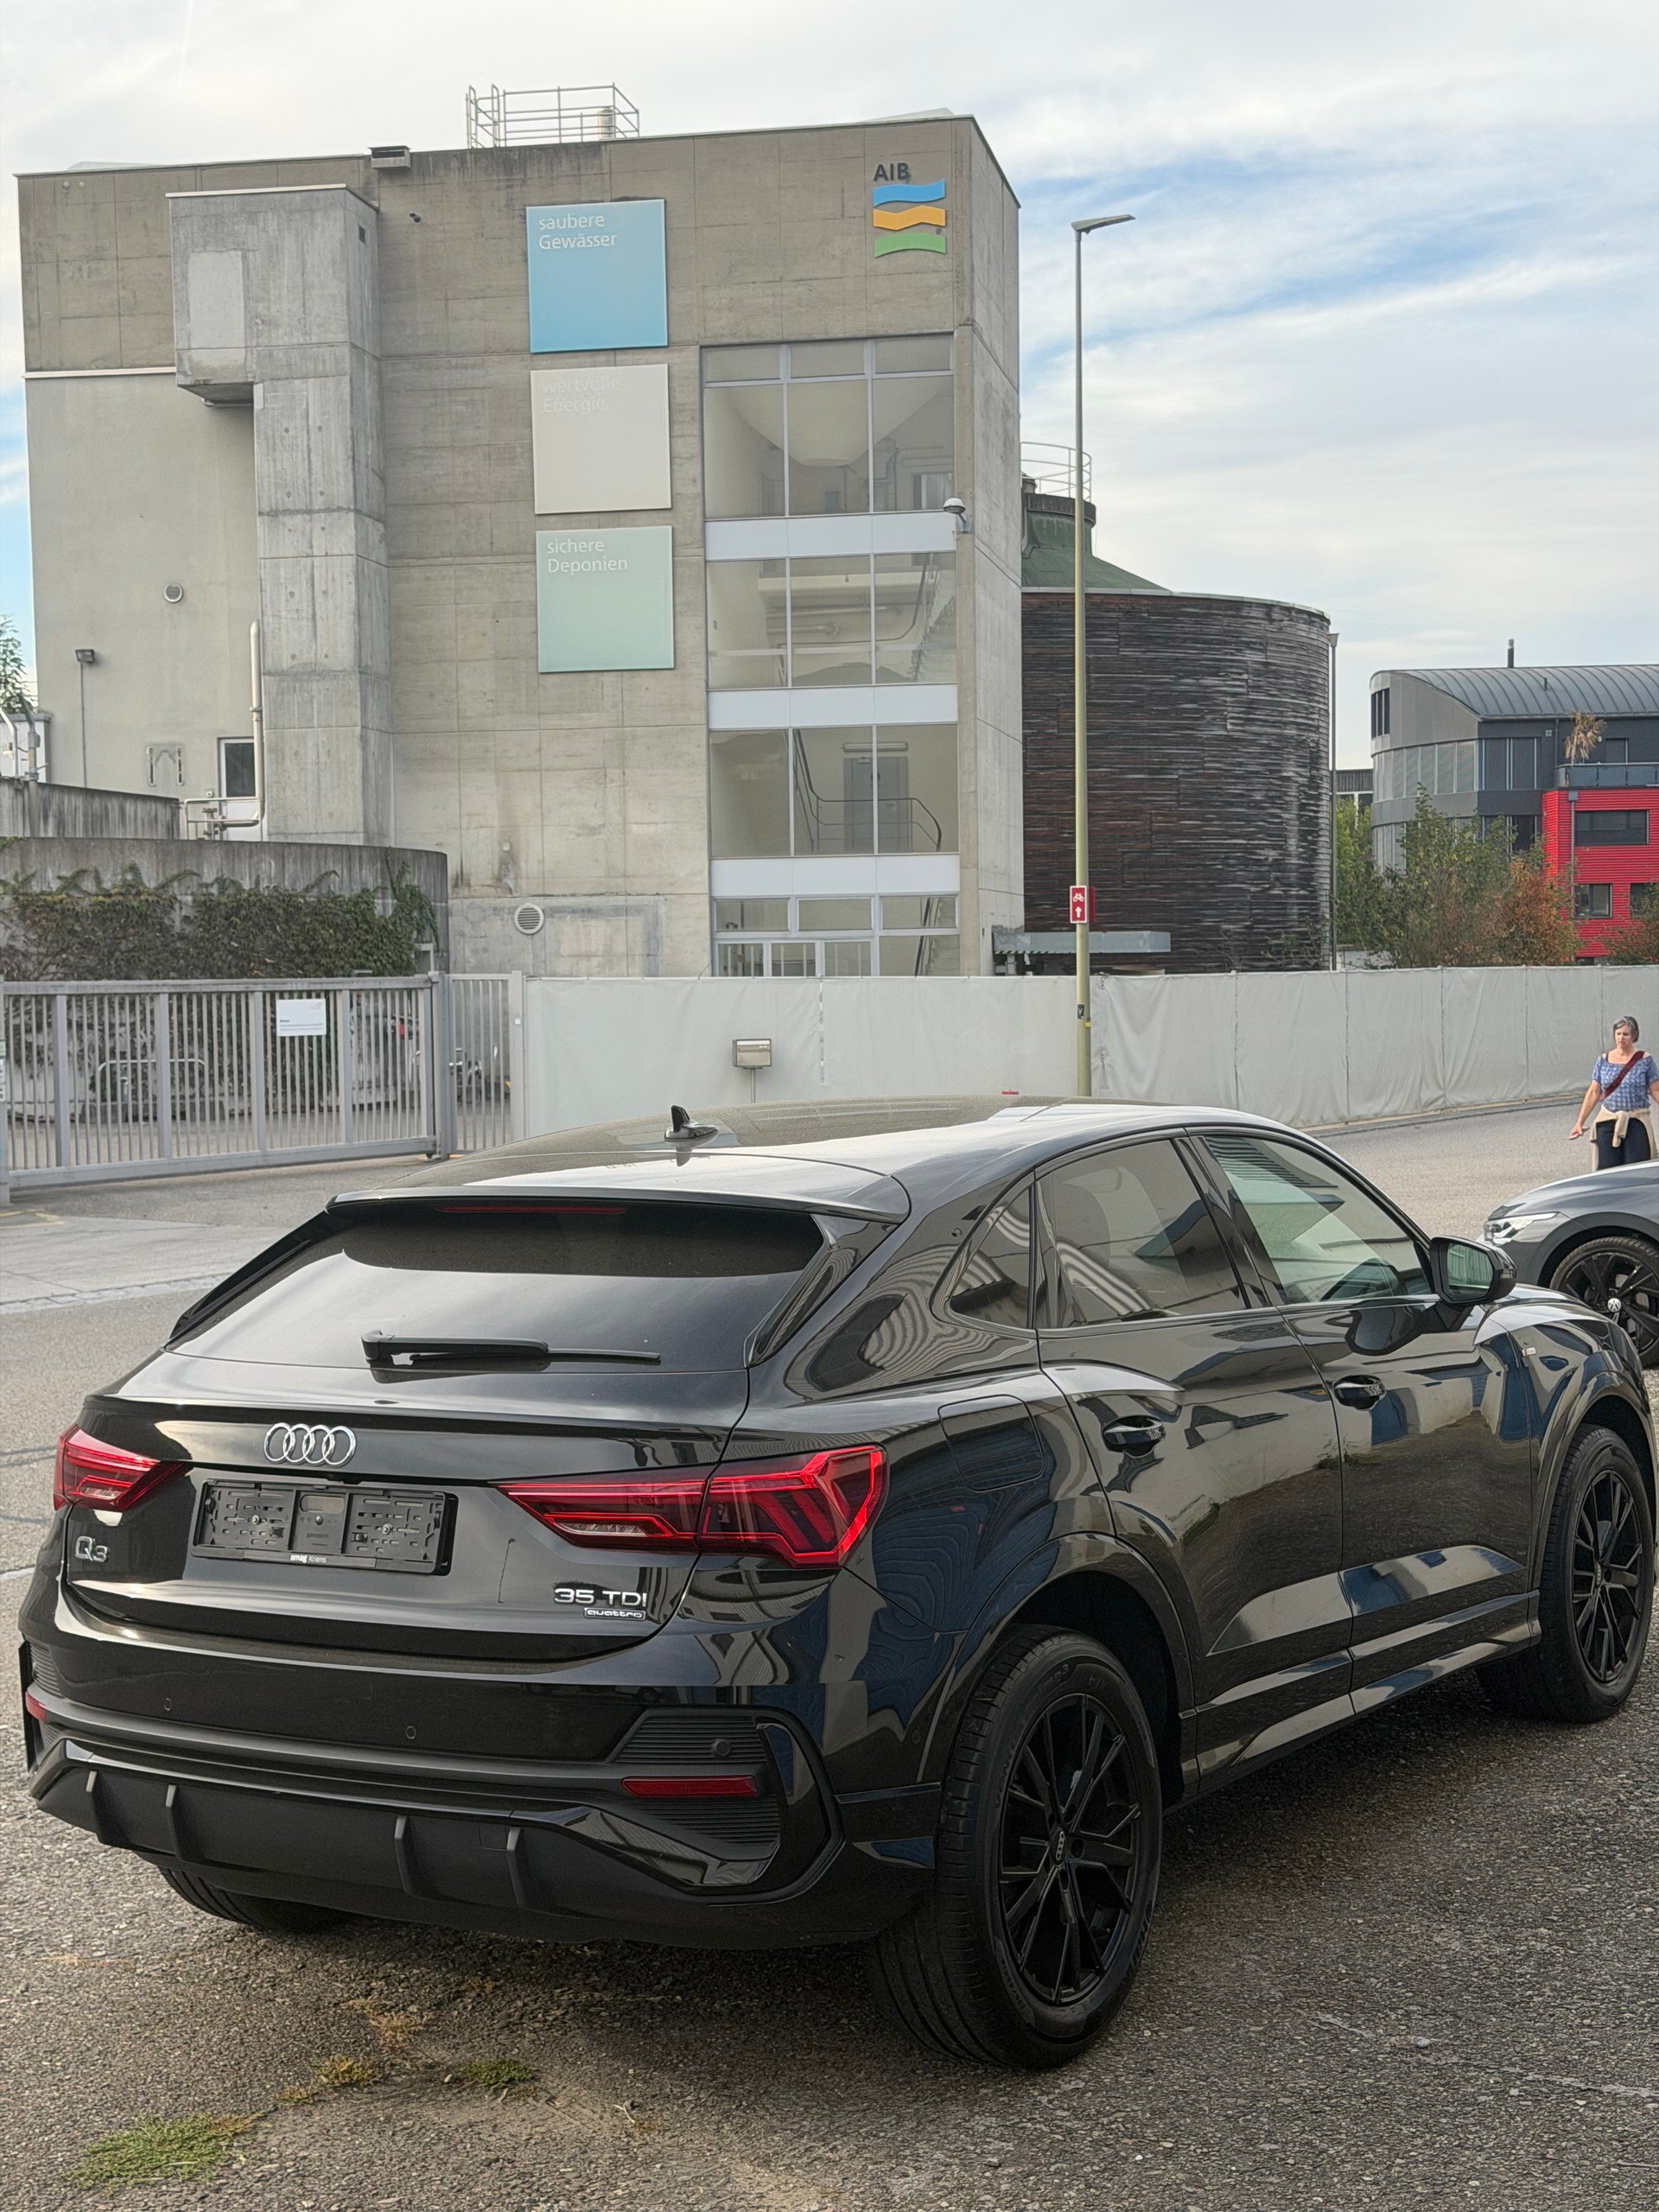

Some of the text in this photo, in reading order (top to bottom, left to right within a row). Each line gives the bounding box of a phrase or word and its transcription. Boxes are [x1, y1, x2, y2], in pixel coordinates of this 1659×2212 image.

[873, 162, 910, 181] AIB
[538, 213, 605, 231] saubere
[538, 233, 618, 251] Gewässer
[546, 538, 605, 555] sichere
[547, 556, 629, 575] Deponien
[74, 1535, 109, 1563] Q3
[290, 1554, 308, 1564] amag
[554, 1588, 648, 1607] 35 TDI
[587, 1608, 643, 1618] quattro
